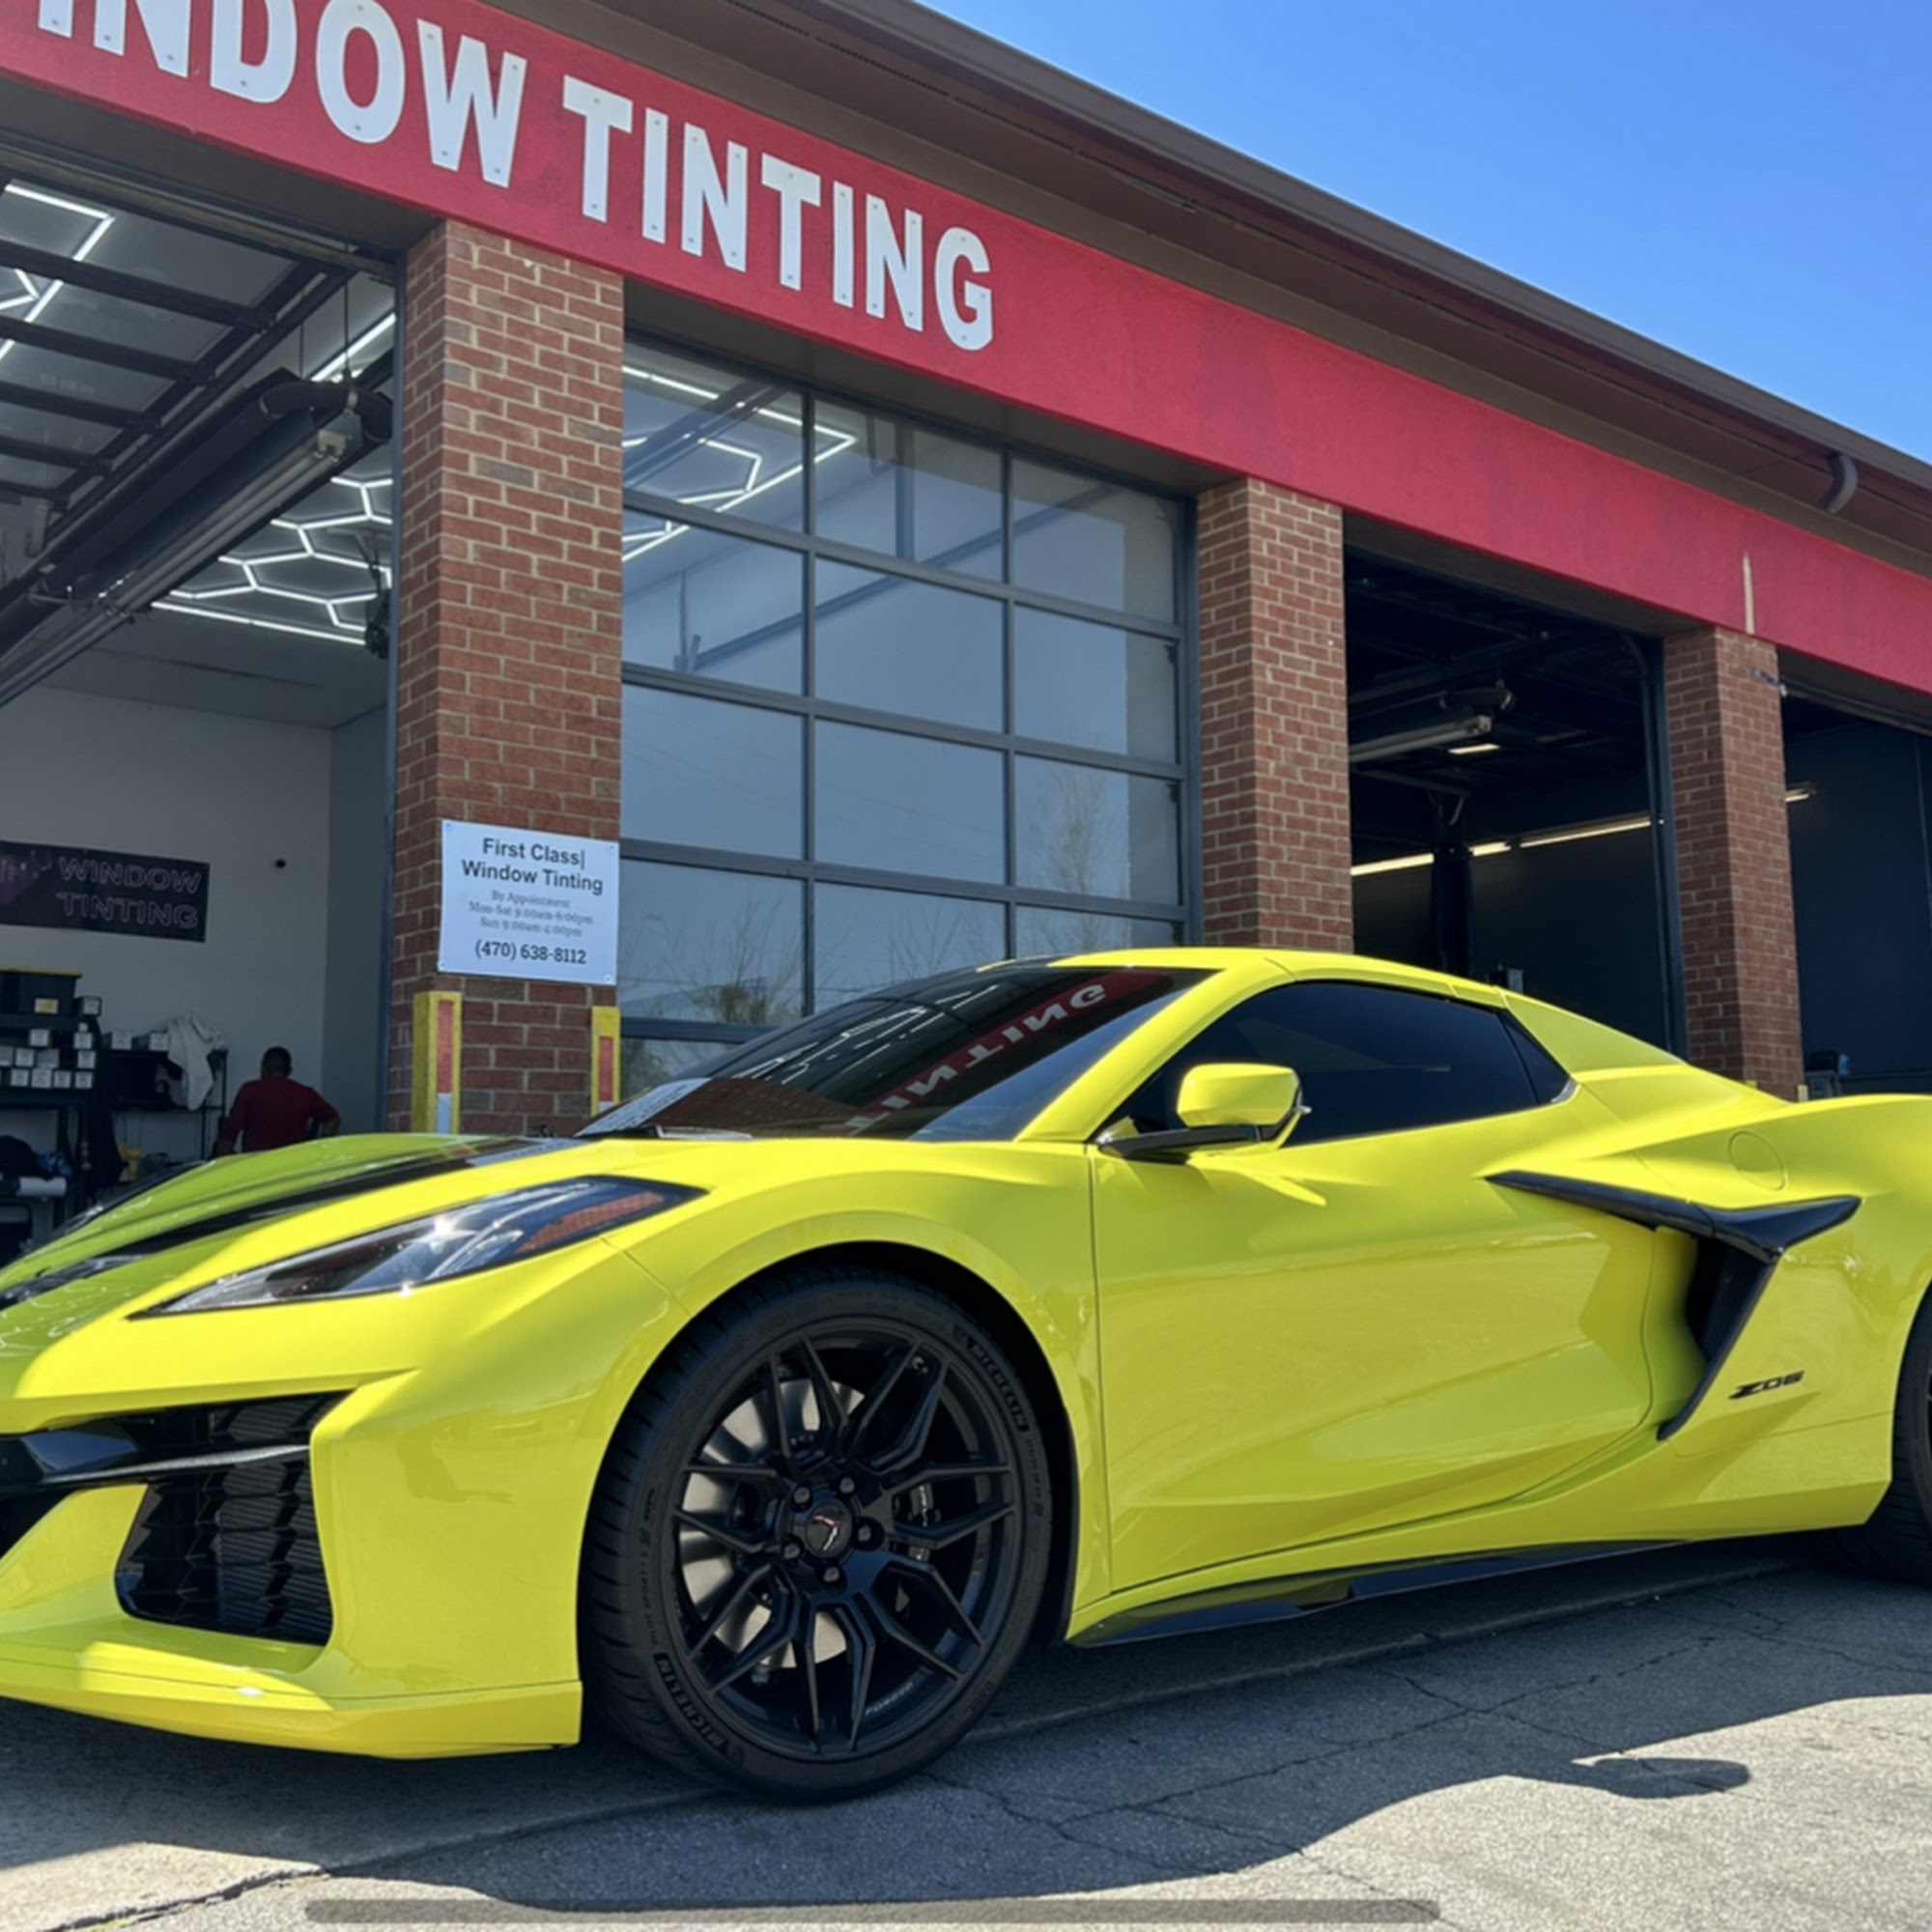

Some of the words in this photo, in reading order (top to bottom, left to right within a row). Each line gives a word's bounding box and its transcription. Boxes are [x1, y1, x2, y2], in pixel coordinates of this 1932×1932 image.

[39, 0, 526, 187] DOW
[563, 75, 993, 351] TINTING
[483, 838, 526, 859] First
[59, 857, 202, 895] WINDOW
[462, 860, 538, 884] Window
[542, 868, 604, 896] Tinting
[56, 892, 198, 929] TINTING
[475, 939, 517, 961] (470)
[520, 944, 587, 964] 638-8112
[969, 1342, 1028, 1428] MICHELIN
[657, 1657, 726, 1750] MICHELIN
